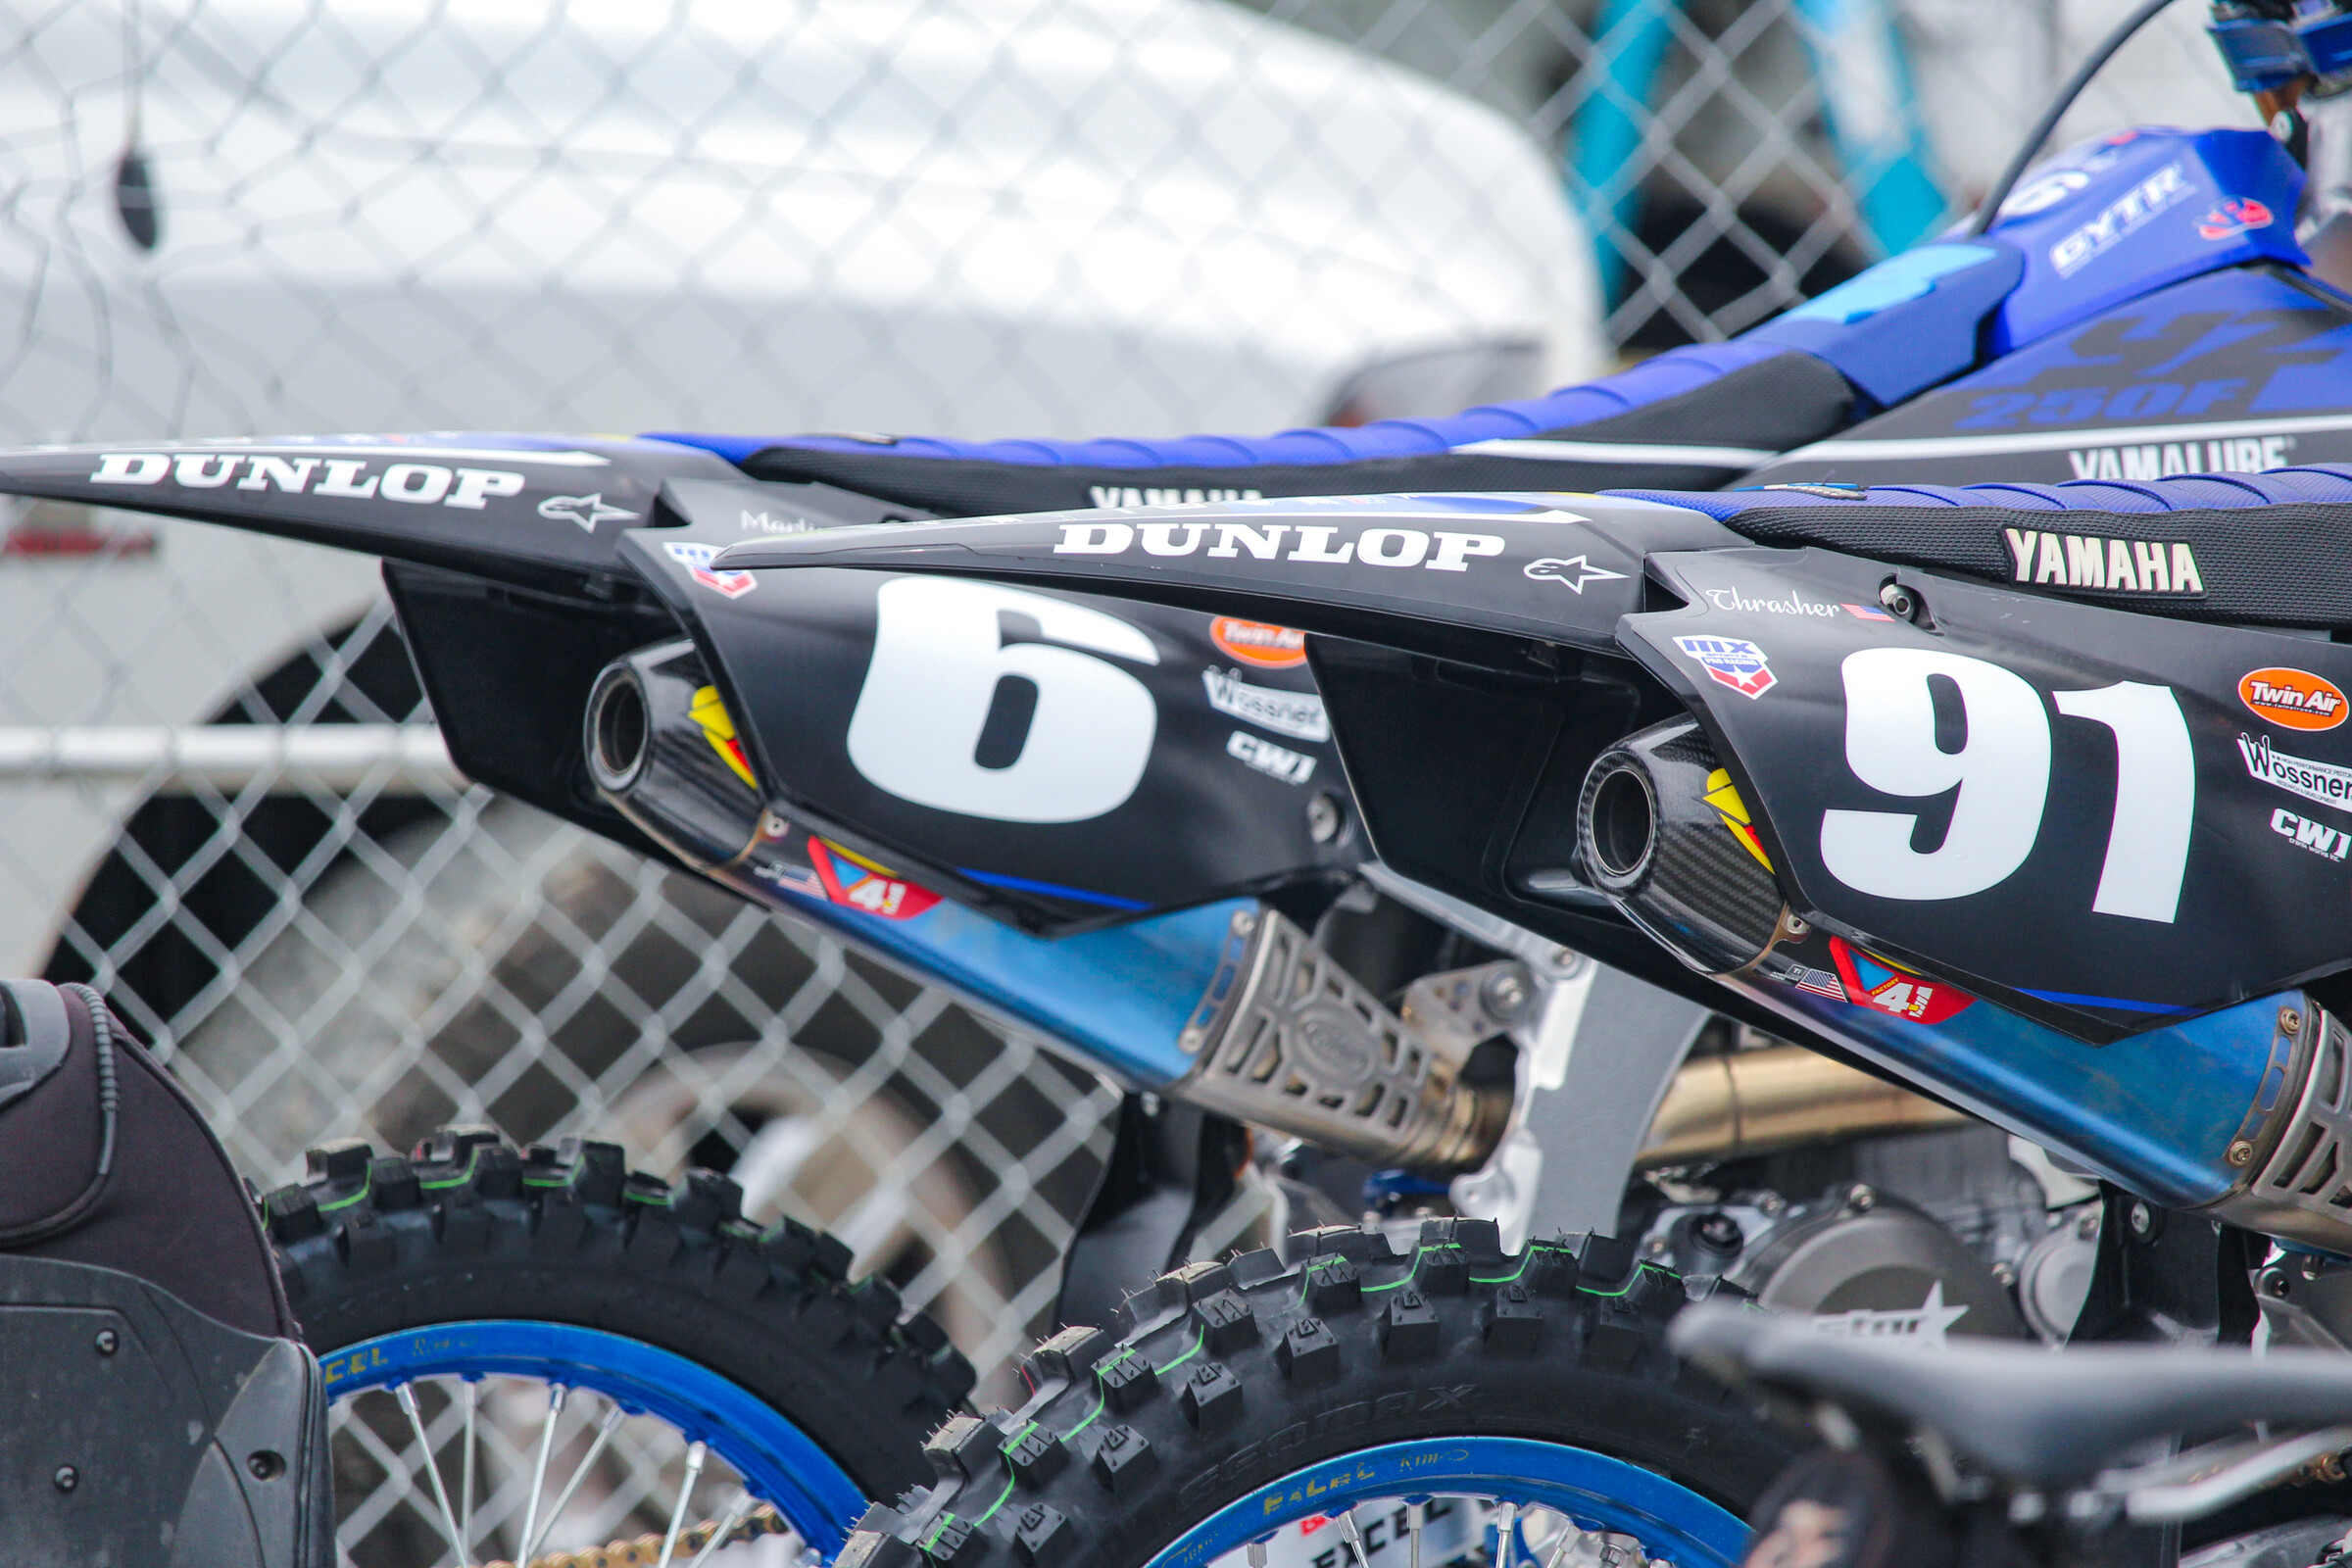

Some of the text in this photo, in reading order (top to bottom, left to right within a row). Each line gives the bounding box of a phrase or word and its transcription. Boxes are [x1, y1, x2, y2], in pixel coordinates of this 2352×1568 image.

[2049, 161, 2193, 276] GYTR
[1954, 378, 2248, 430] 250F
[90, 453, 526, 511] DUNLOP
[1053, 522, 1506, 572] DUNLOP
[2004, 527, 2204, 593] YAMAHA
[1705, 585, 1839, 617] Thrasher
[847, 574, 1160, 824] 6
[2249, 680, 2342, 713] Twin Air
[1820, 647, 2196, 924] 91
[1871, 977, 1900, 996] FACTORY
[325, 1347, 389, 1385] CEL
